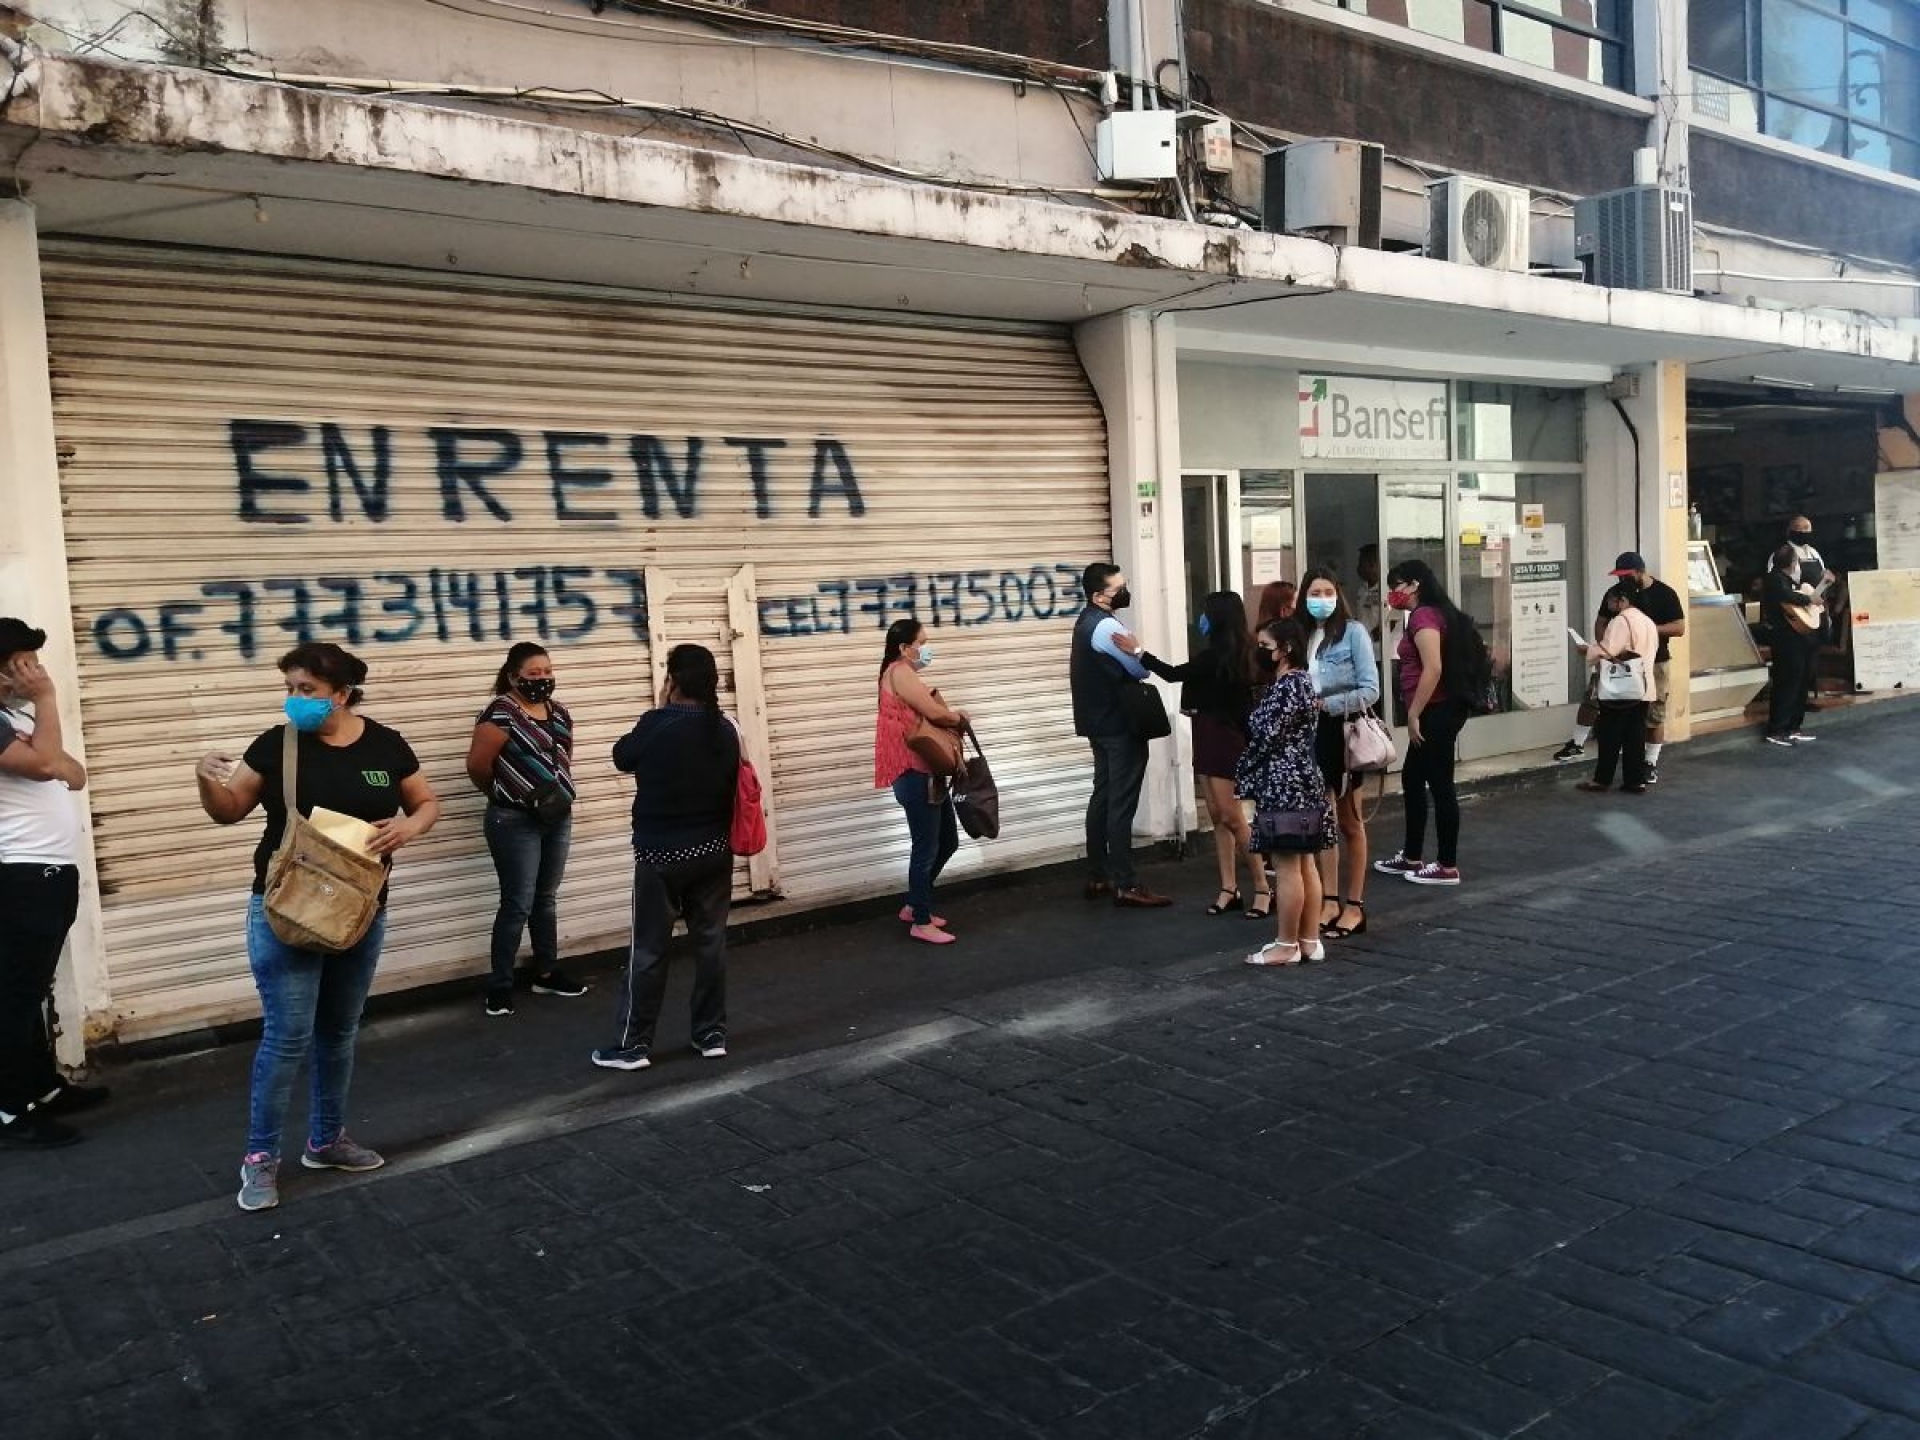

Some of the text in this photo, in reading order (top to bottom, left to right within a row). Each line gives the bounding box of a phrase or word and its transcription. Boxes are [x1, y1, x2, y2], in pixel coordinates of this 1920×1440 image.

[1331, 393, 1447, 440] Bansefi
[229, 418, 865, 523] EN RENTA
